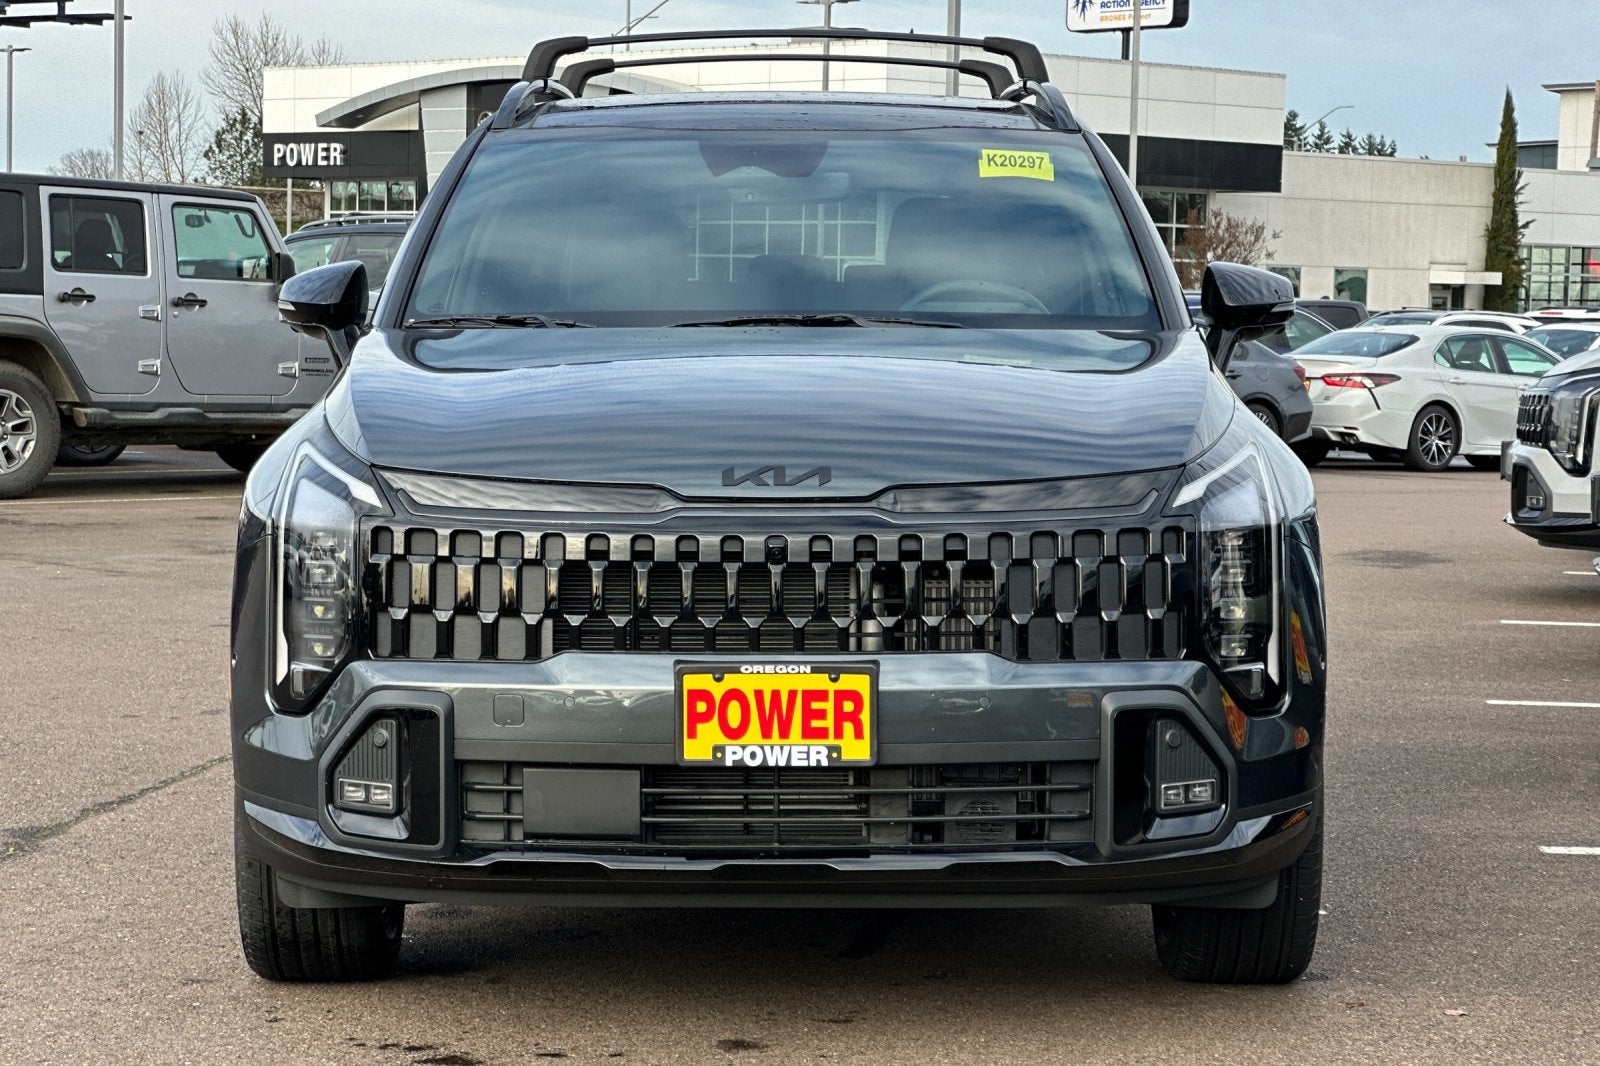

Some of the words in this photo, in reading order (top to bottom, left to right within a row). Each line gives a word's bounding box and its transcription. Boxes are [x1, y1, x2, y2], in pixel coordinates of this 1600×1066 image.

[1100, 0, 1130, 9] ACTION
[1133, 0, 1165, 8] GENCY
[273, 143, 343, 166] POWER
[986, 153, 1044, 169] K20297
[721, 465, 832, 487] KIA
[740, 664, 812, 674] OREGON
[686, 687, 865, 741] POWER
[725, 745, 829, 767] POWER
